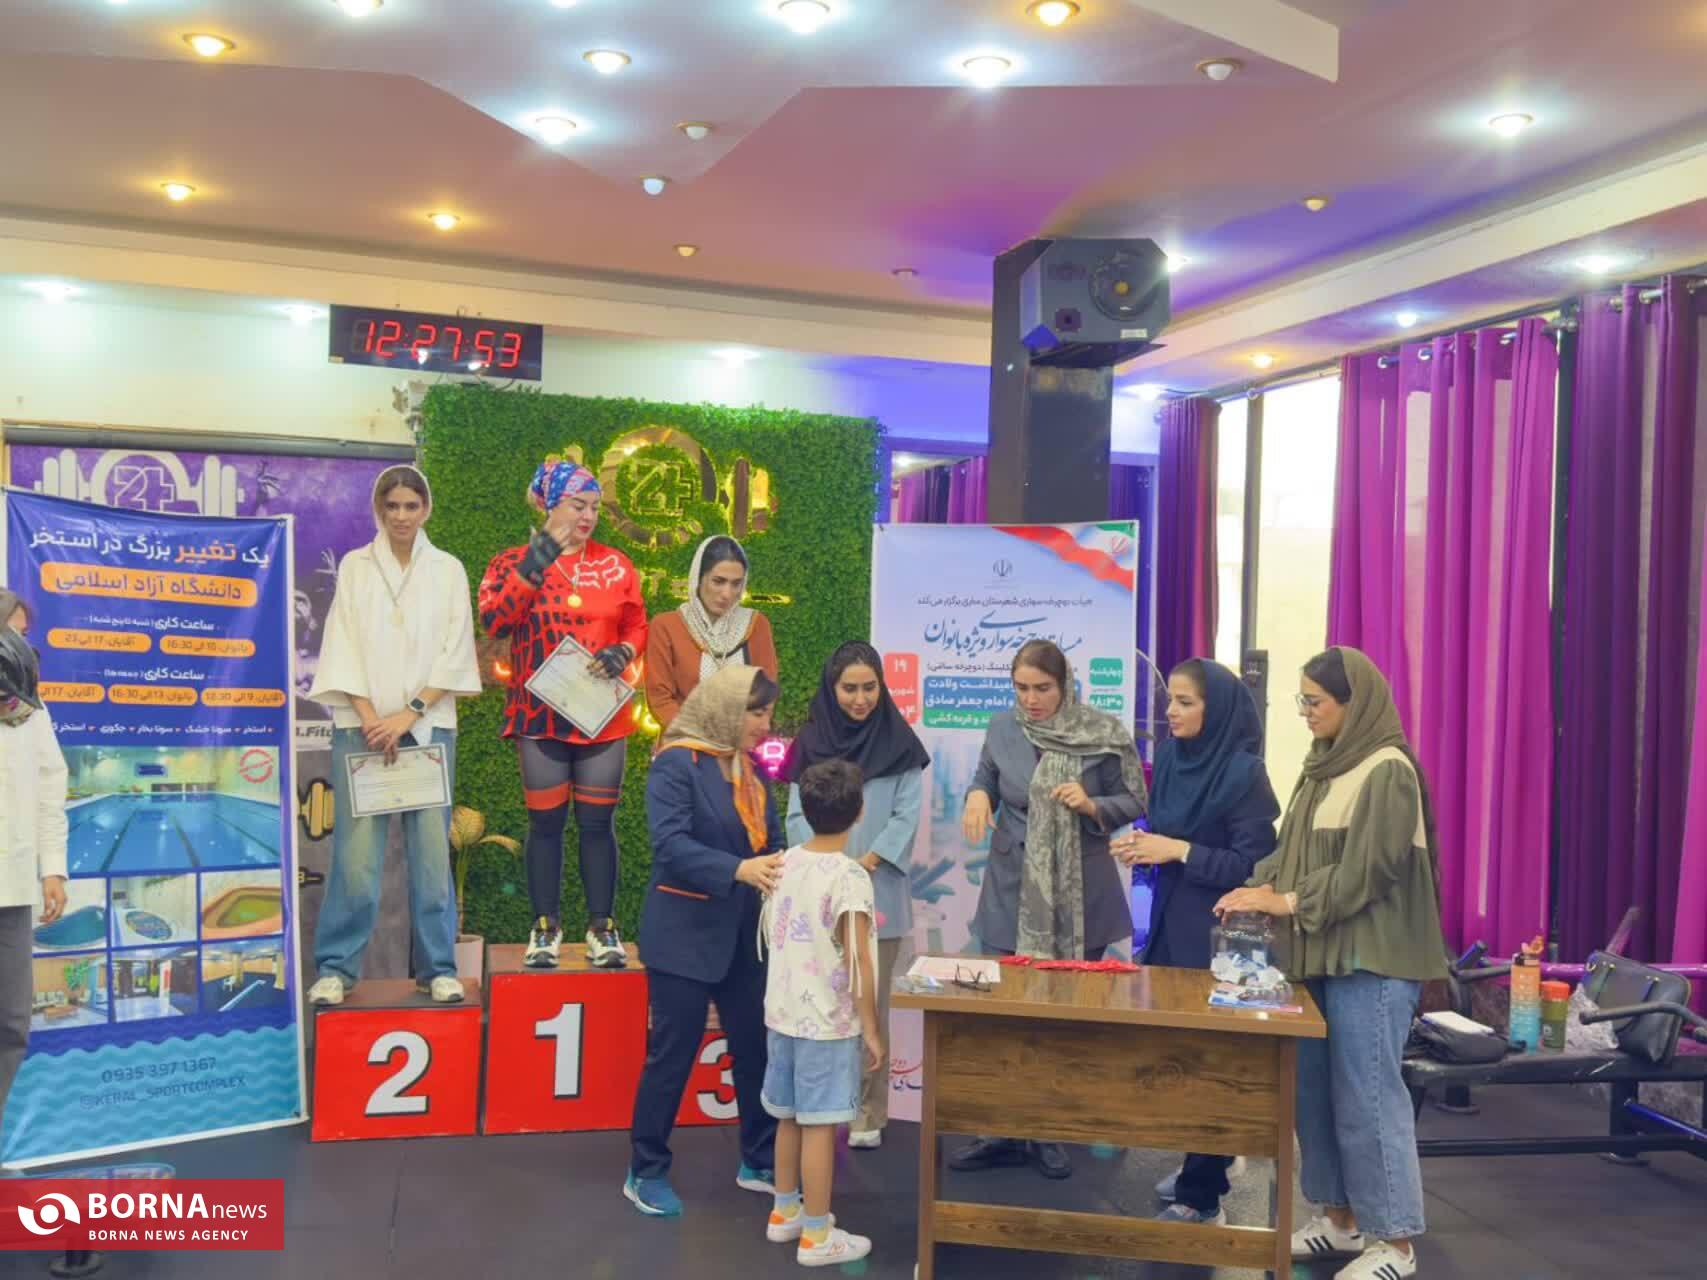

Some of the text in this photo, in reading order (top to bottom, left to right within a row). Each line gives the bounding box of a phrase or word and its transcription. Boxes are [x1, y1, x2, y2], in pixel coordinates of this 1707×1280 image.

[364, 319, 522, 369] 12:27:53
[29, 526, 270, 570] یک تغییر بزرگ در استخر
[55, 571, 241, 600] دانشگاه آزاد اسلامی
[181, 618, 215, 632] ساعت
[894, 658, 908, 673] ۱۹
[170, 668, 205, 681] ساعت
[928, 678, 958, 692] ولادت
[925, 694, 956, 707] صادق
[955, 695, 983, 708] جعفر
[984, 696, 1007, 708] امام
[534, 1002, 585, 1099] 1
[363, 1030, 432, 1118] 2
[697, 1036, 739, 1120] 3
